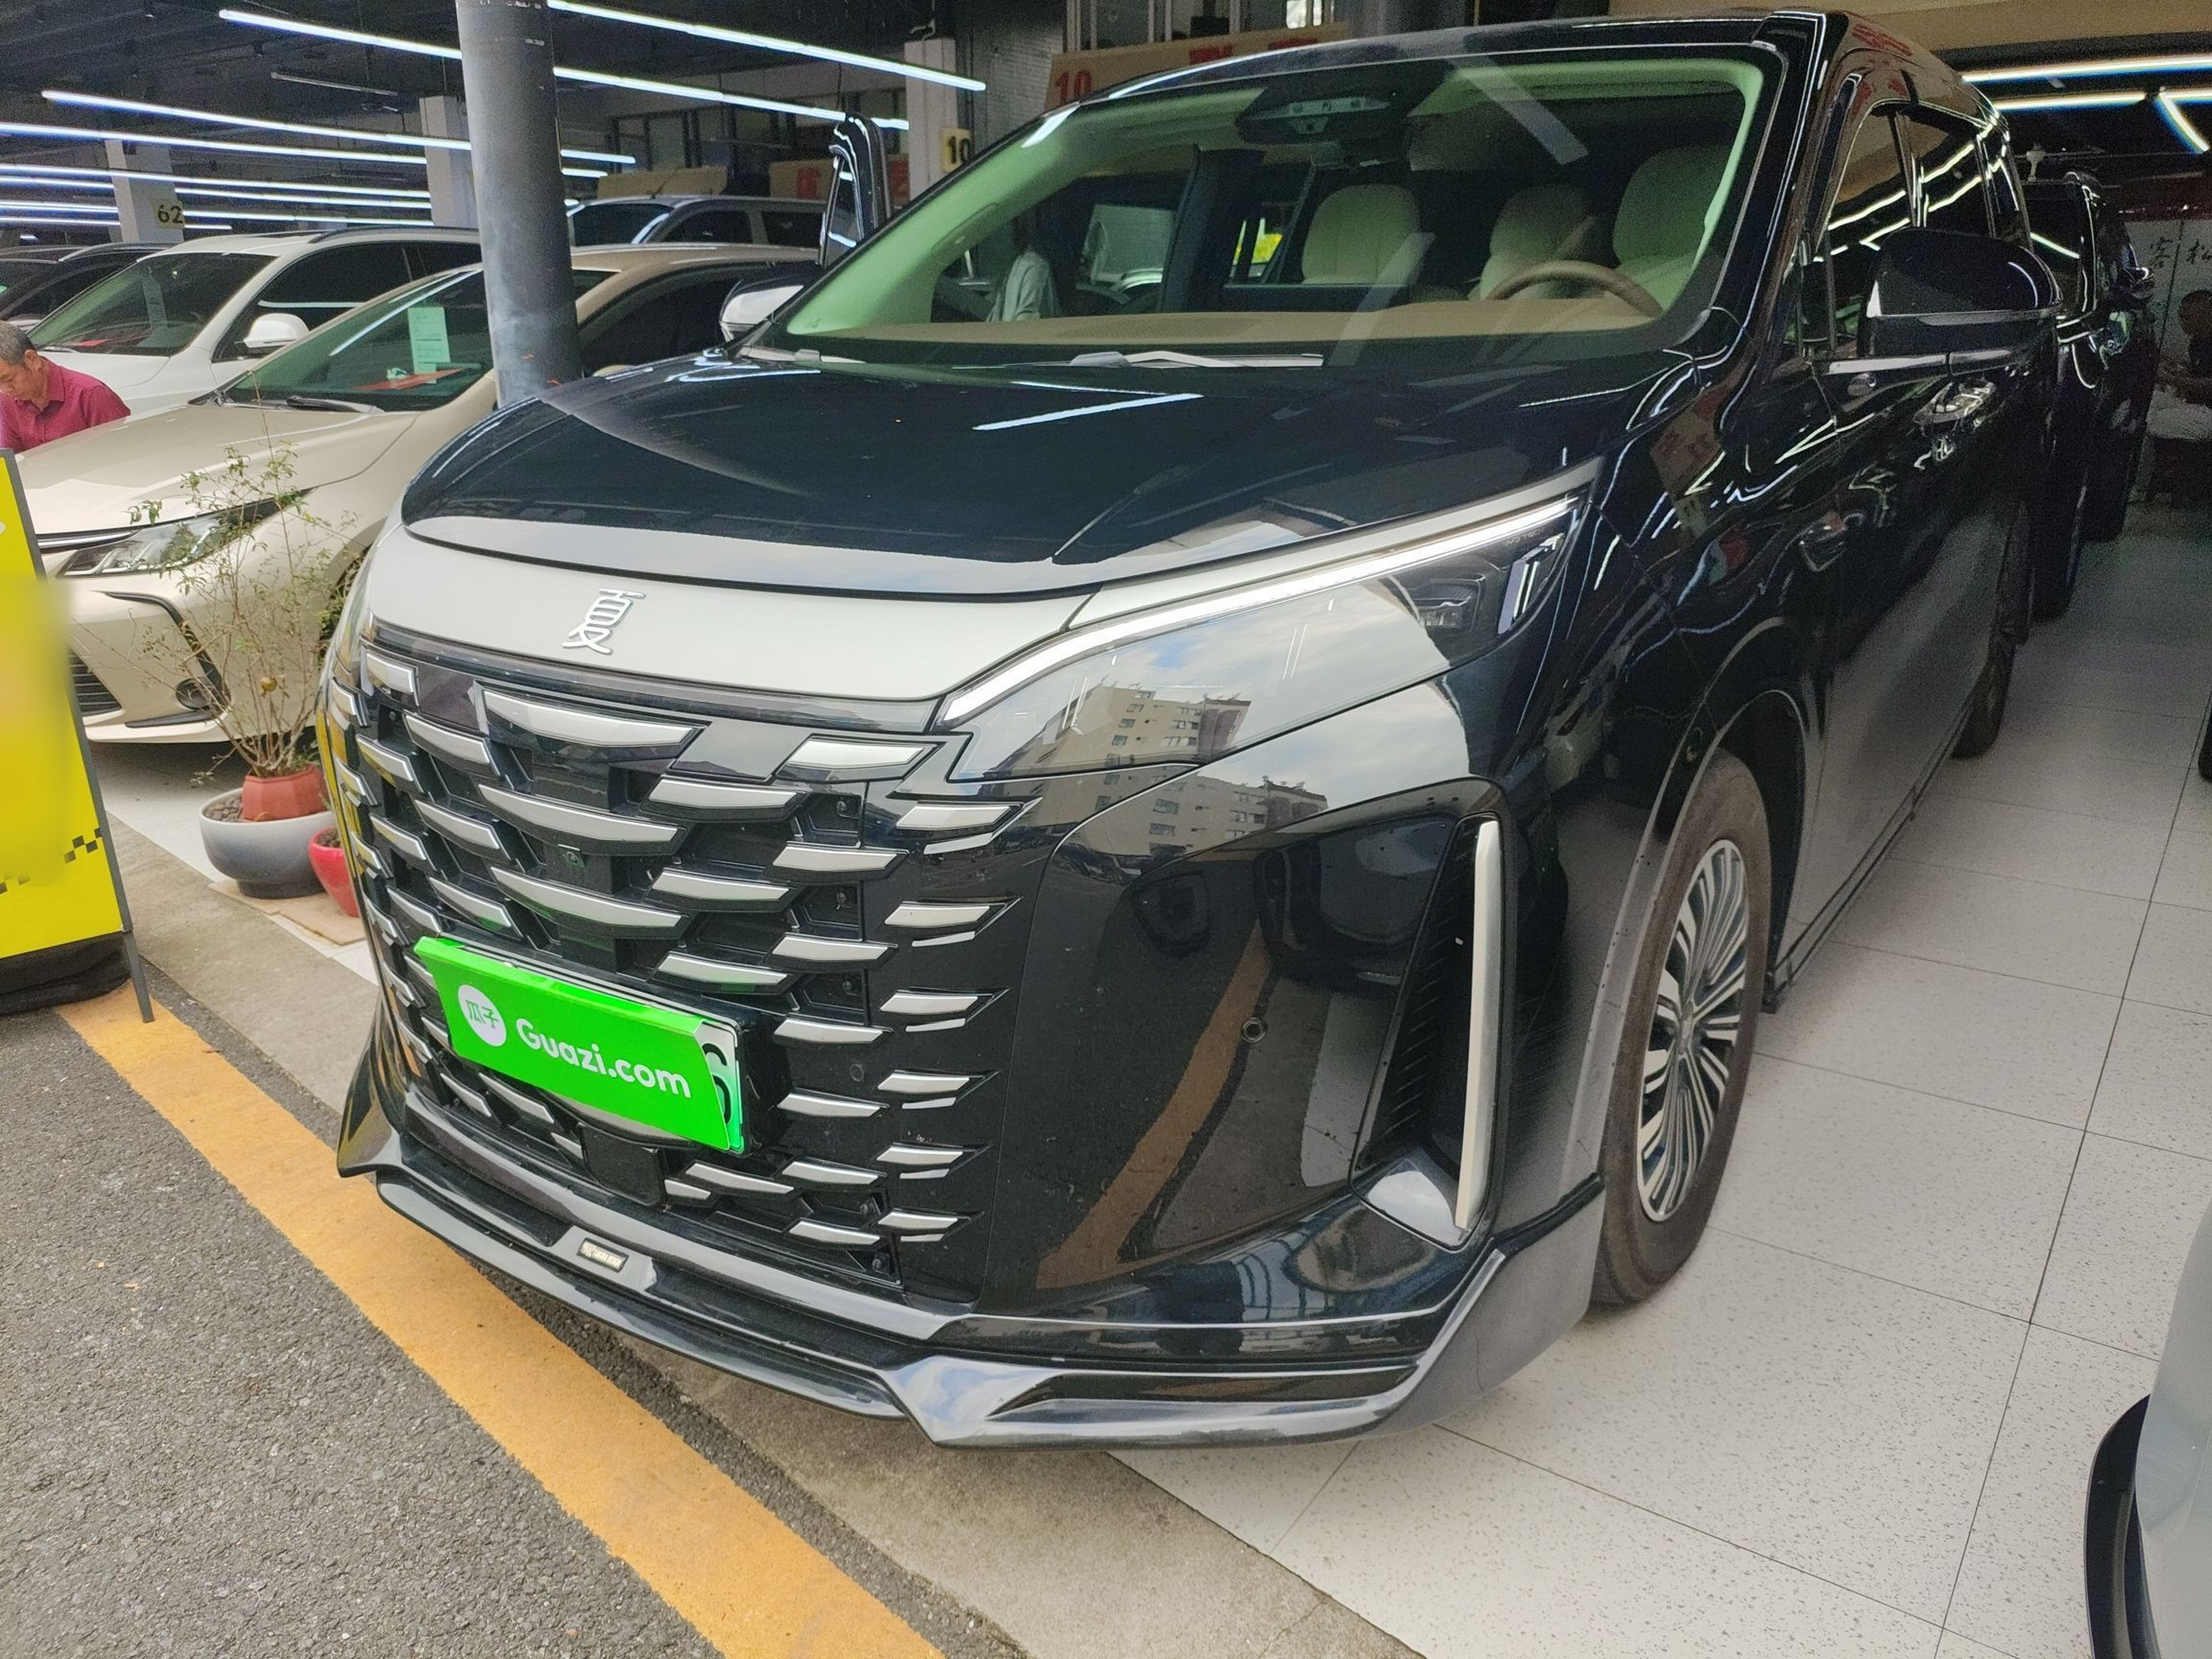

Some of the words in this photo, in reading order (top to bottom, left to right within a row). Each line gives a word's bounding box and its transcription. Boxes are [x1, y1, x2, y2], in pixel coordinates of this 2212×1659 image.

[948, 136, 971, 164] 10
[158, 204, 183, 224] 62
[562, 588, 646, 655] 夏
[465, 999, 499, 1029] 瓜子
[516, 1018, 691, 1098] Guazi.com
